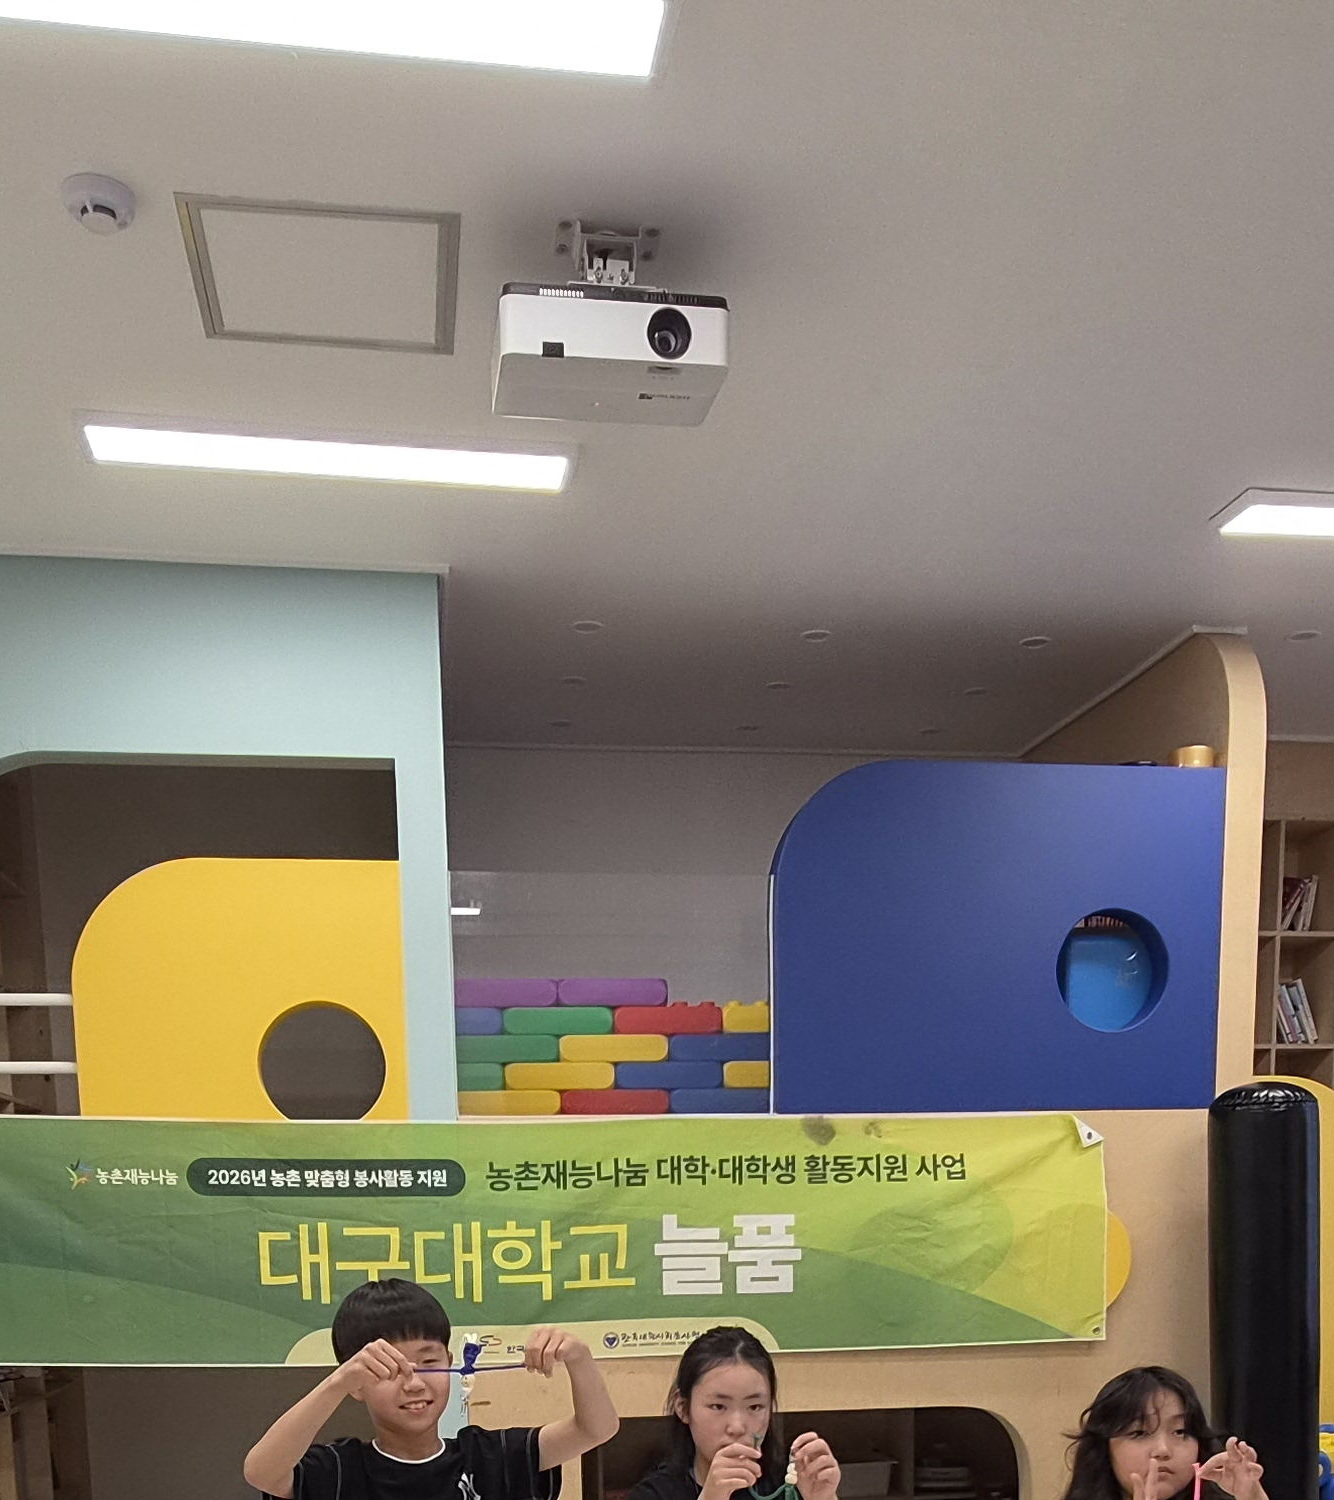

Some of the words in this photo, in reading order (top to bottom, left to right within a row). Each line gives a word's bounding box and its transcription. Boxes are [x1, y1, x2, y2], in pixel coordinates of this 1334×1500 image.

[96, 1168, 178, 1186] 농촌재능나눔
[208, 1169, 266, 1187] 2026년
[270, 1169, 301, 1187] 농촌
[304, 1169, 350, 1188] 맞춤형
[353, 1169, 414, 1188] 봉사활동
[417, 1169, 447, 1188] 지원
[485, 1157, 649, 1191] 농촌재능나눔
[803, 1153, 908, 1184] 활동지원
[916, 1153, 967, 1182] 사업
[258, 1219, 636, 1304] 대구대학교
[654, 1213, 802, 1296] 늘품
